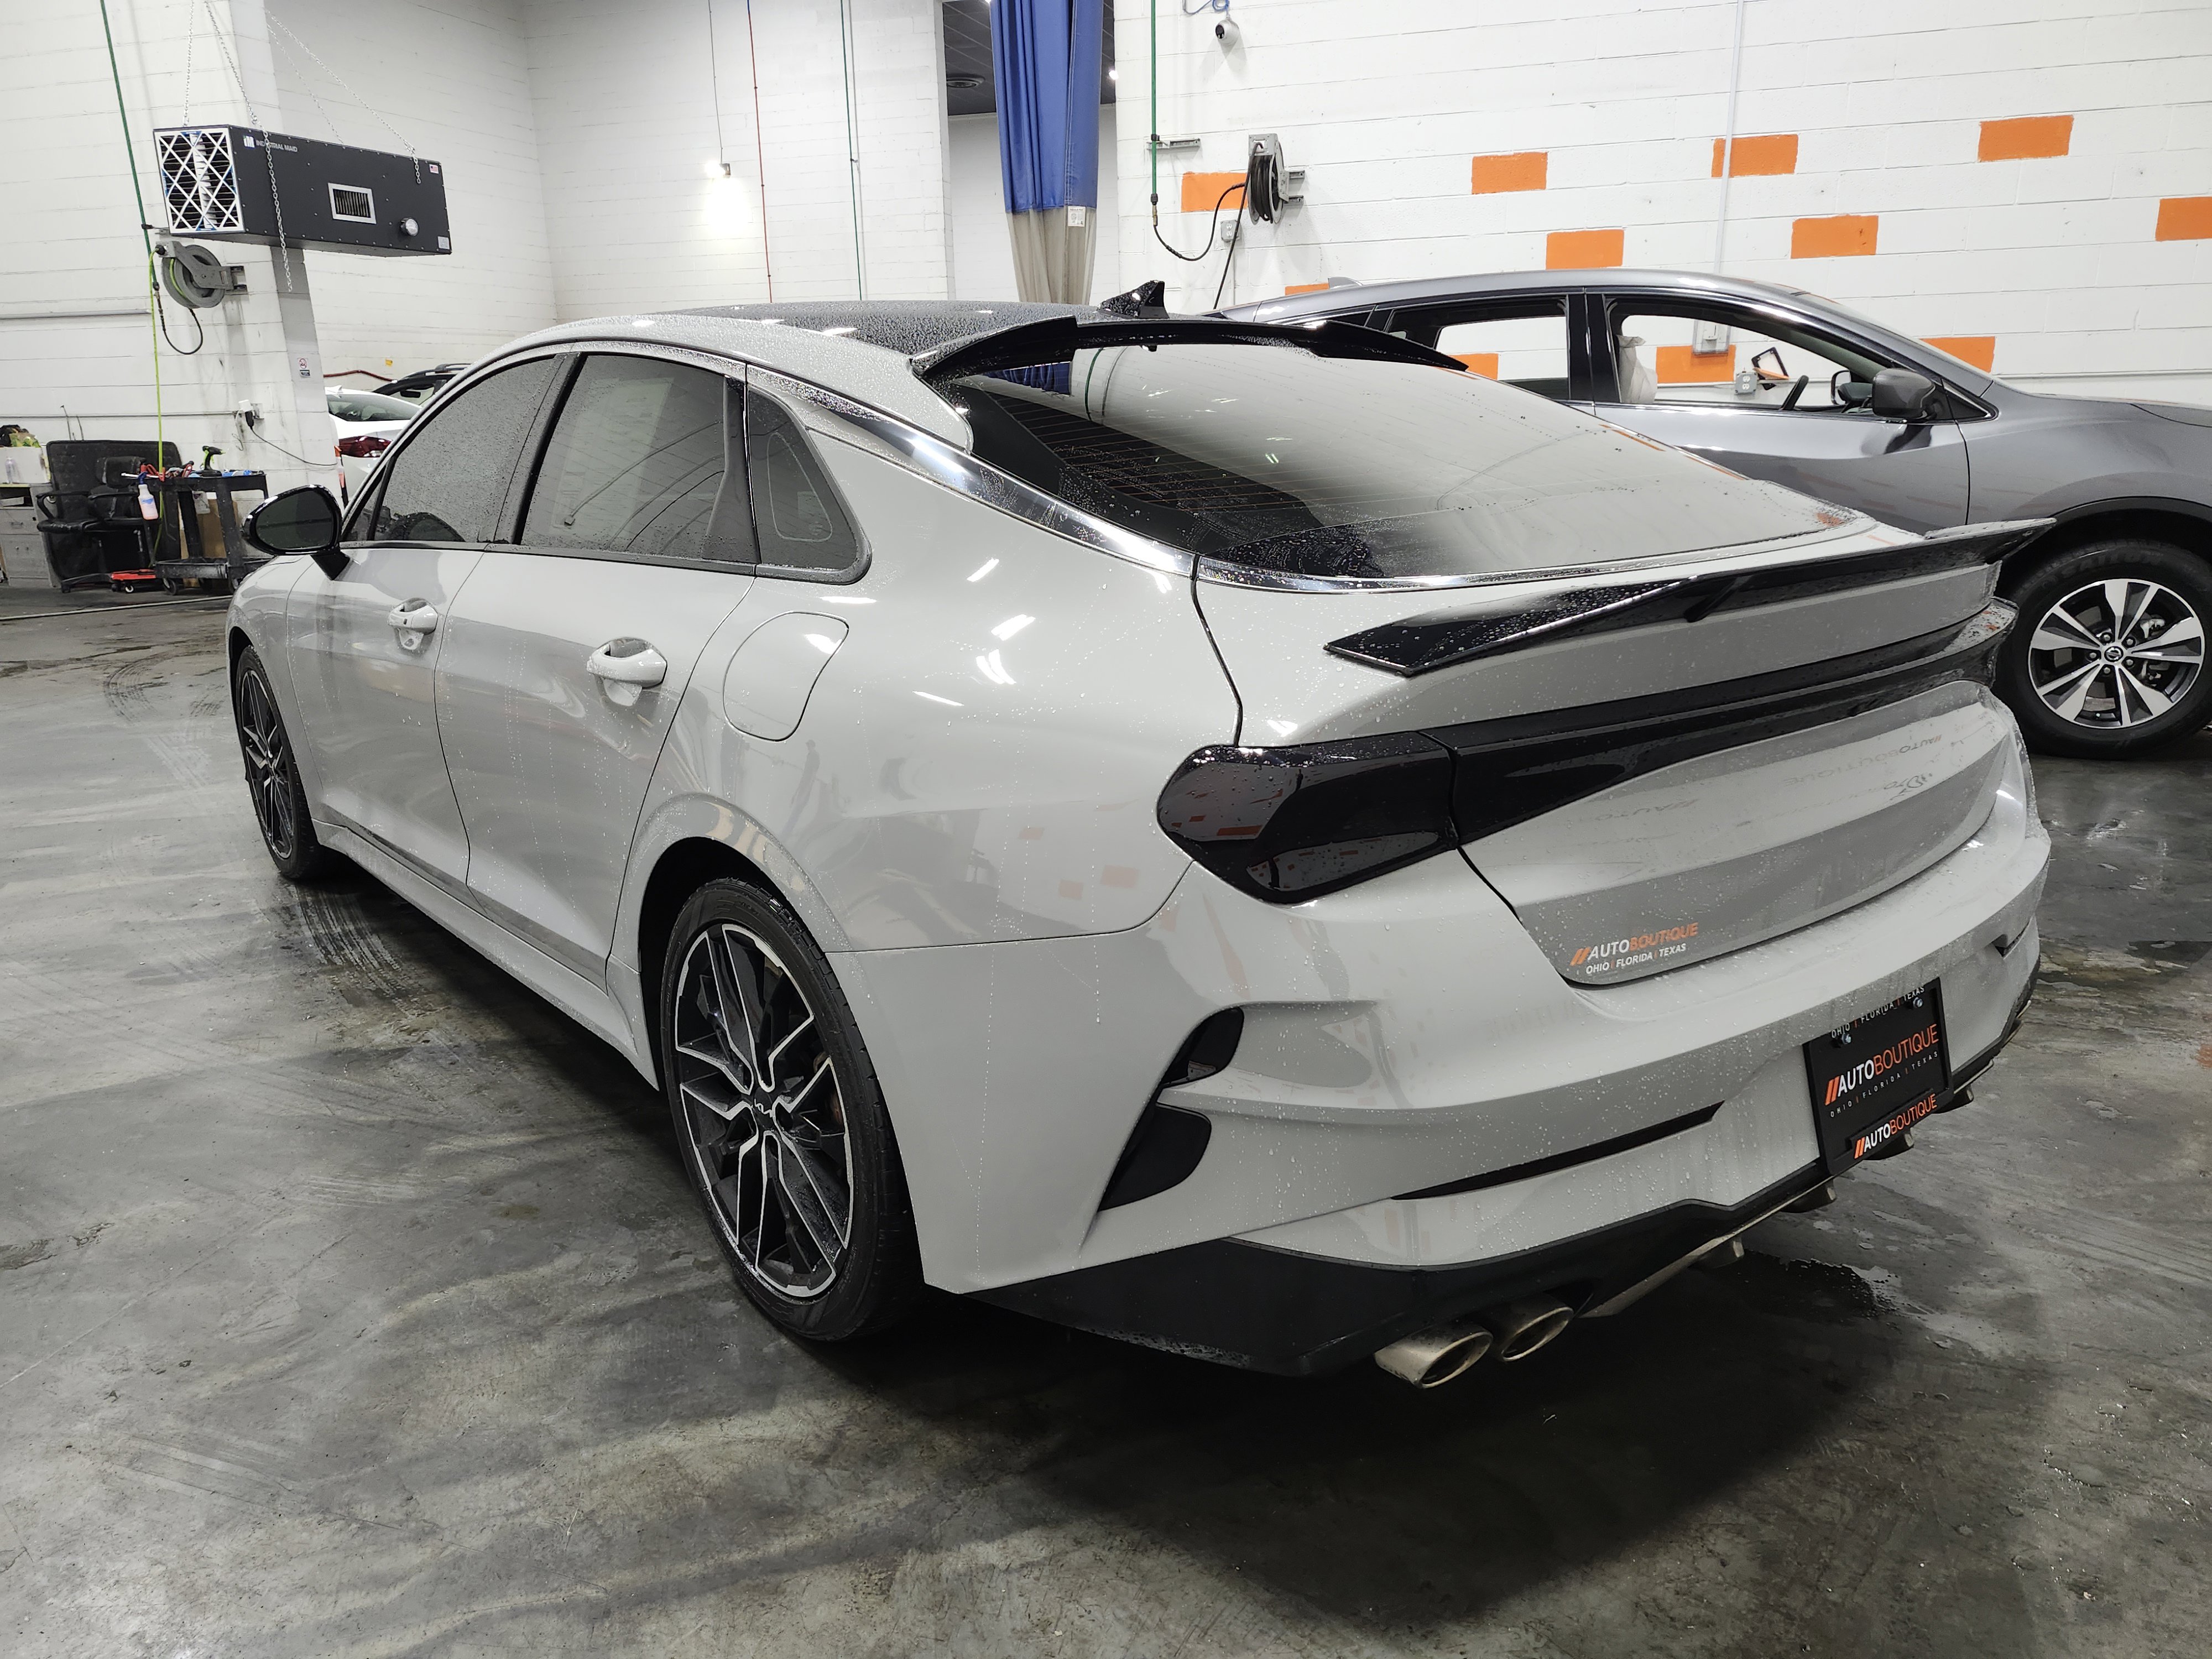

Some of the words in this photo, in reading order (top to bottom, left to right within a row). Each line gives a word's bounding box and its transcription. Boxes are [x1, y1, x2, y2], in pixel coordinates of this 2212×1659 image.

[1585, 962, 1610, 974] OHIO
[1616, 952, 1653, 968] FLORIDA
[1659, 943, 1687, 957] TEXAS
[1832, 1023, 1850, 1039] OHIO
[1830, 1100, 1852, 1118] OHIO
[1862, 1073, 1902, 1099] FLORIDA
[1911, 1051, 1938, 1070] TEXAS
